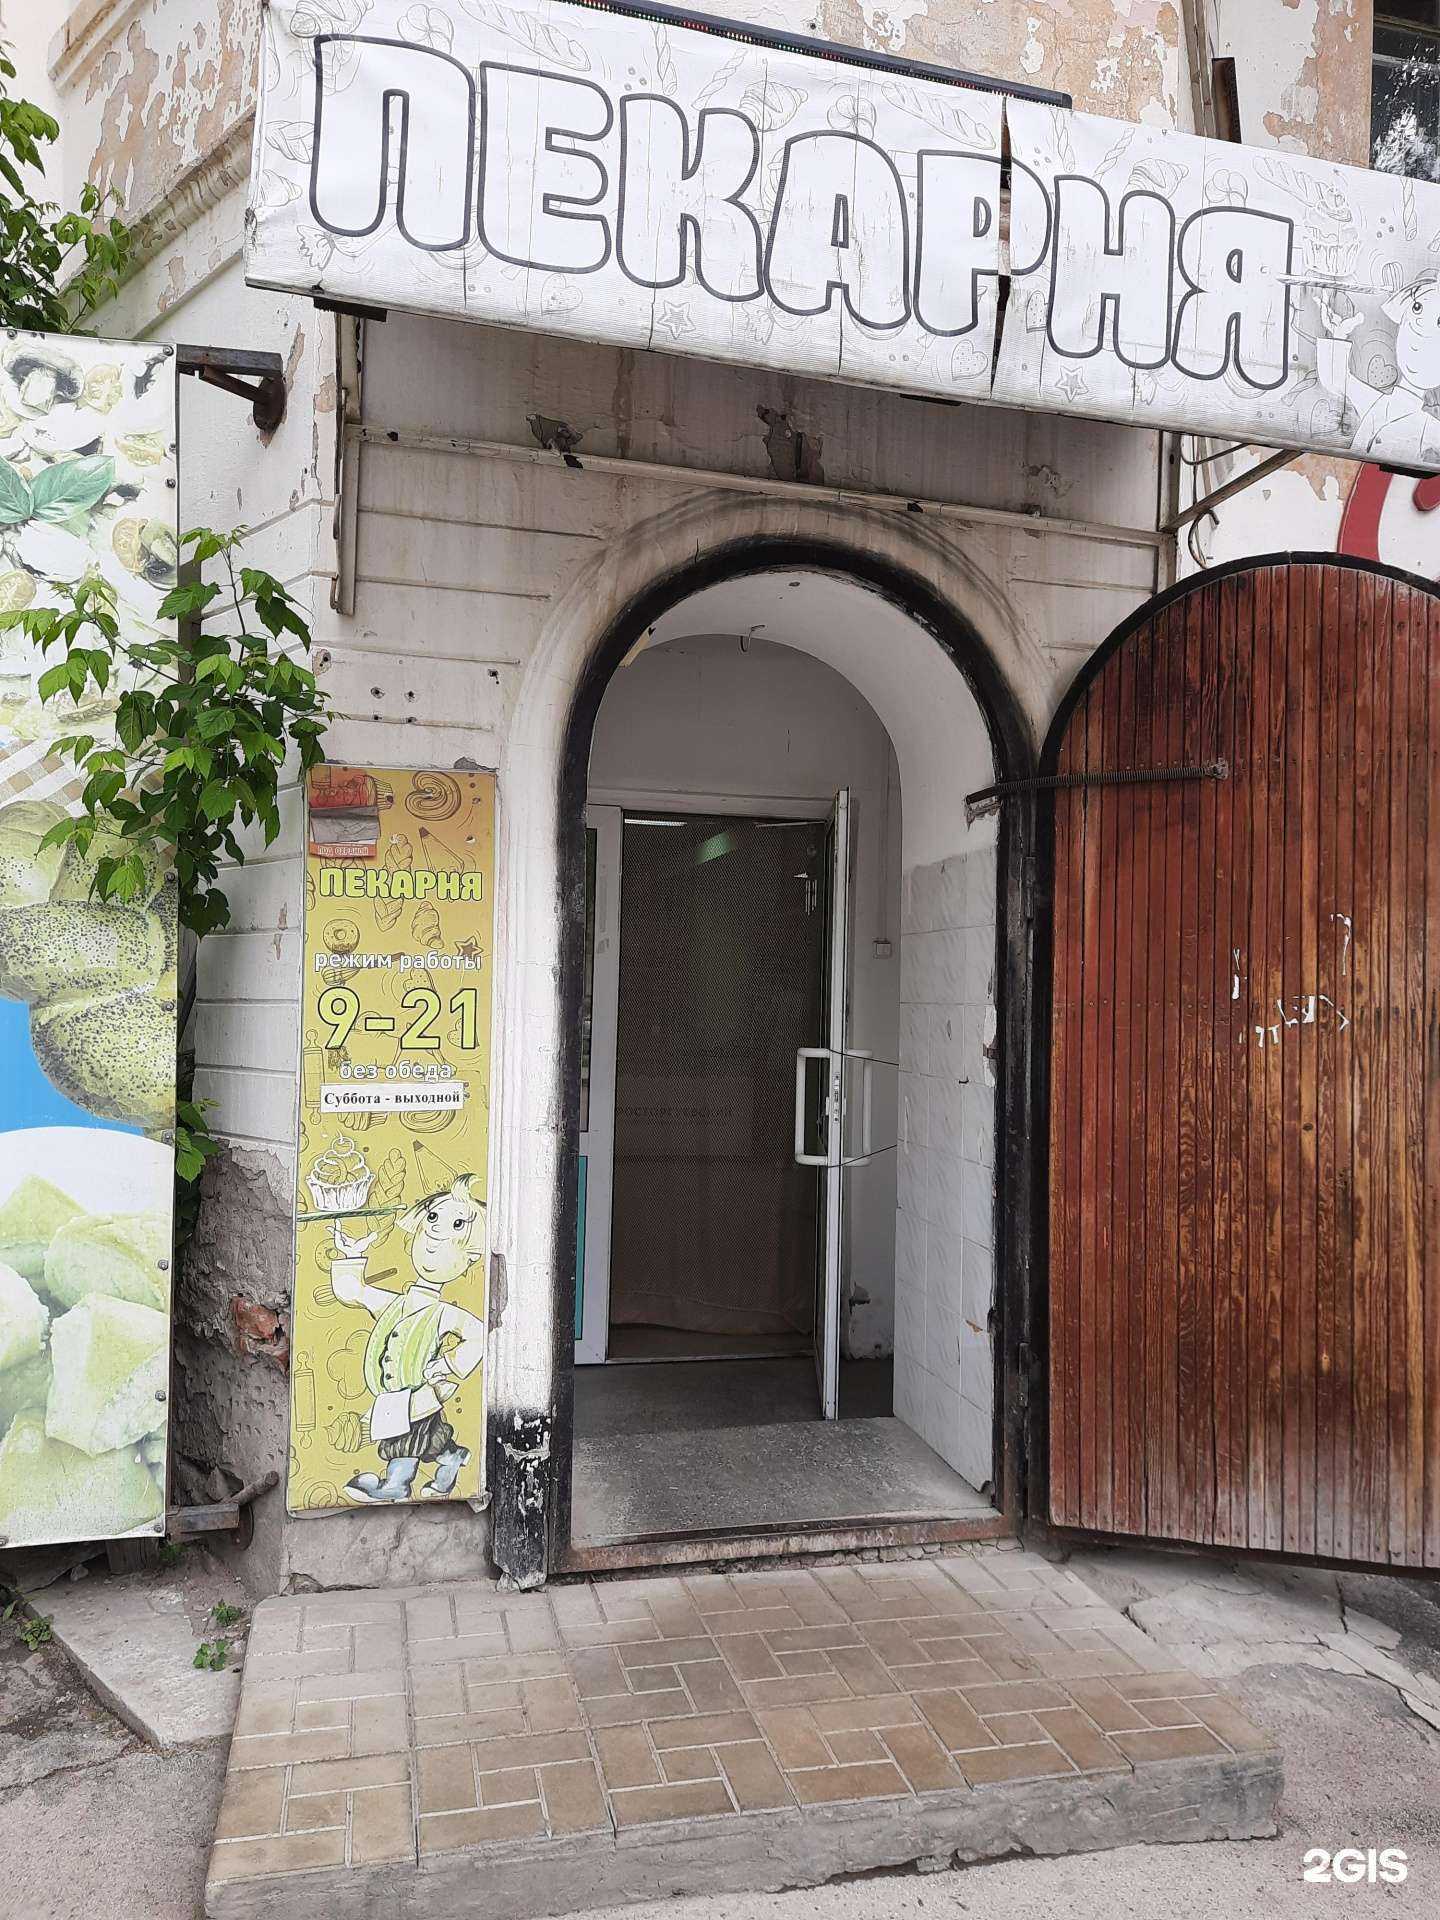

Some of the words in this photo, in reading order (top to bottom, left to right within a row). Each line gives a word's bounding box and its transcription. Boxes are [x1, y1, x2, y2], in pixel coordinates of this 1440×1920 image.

[309, 34, 1295, 391] ПЕКАРНЯ
[320, 867, 482, 901] ПЕКАРНЯ
[315, 952, 392, 972] режим
[400, 950, 481, 973] работы
[318, 986, 477, 1050] 9-21
[340, 1060, 378, 1079] без
[385, 1060, 452, 1082] обеда
[324, 1092, 381, 1107] Суббота
[395, 1090, 460, 1105] выходной
